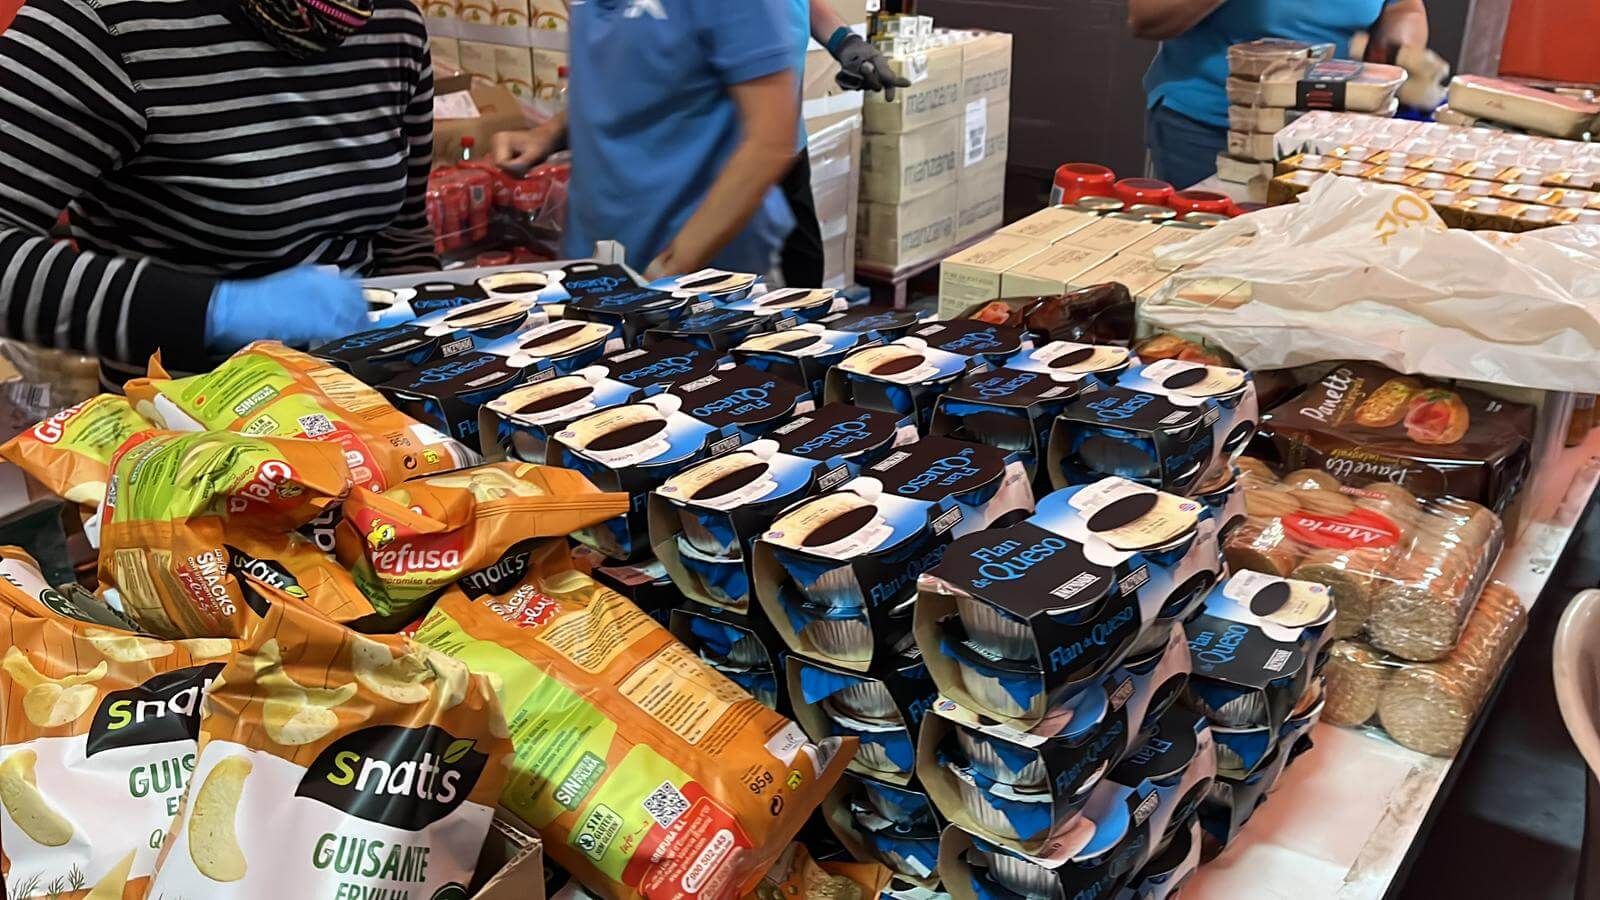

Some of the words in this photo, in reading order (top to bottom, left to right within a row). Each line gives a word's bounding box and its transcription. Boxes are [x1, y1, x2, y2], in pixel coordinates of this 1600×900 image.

[691, 387, 771, 417] Queso
[728, 399, 772, 417] Flan
[792, 420, 868, 455] Queso
[829, 430, 873, 449] Flan
[897, 455, 973, 495] Queso
[938, 467, 981, 487] Flan
[970, 538, 1023, 564] Flan
[978, 537, 1069, 582] Queso
[196, 551, 238, 617] SNACKS
[970, 576, 990, 590] de
[1048, 641, 1085, 673] Flan
[1091, 605, 1135, 647] Queso
[1196, 624, 1249, 665] Queso
[554, 776, 582, 807] SIN
[749, 770, 774, 796] 95g
[585, 810, 606, 833] SIN
[591, 814, 617, 842] GLUTEN
[312, 832, 431, 884] GUISANTE
